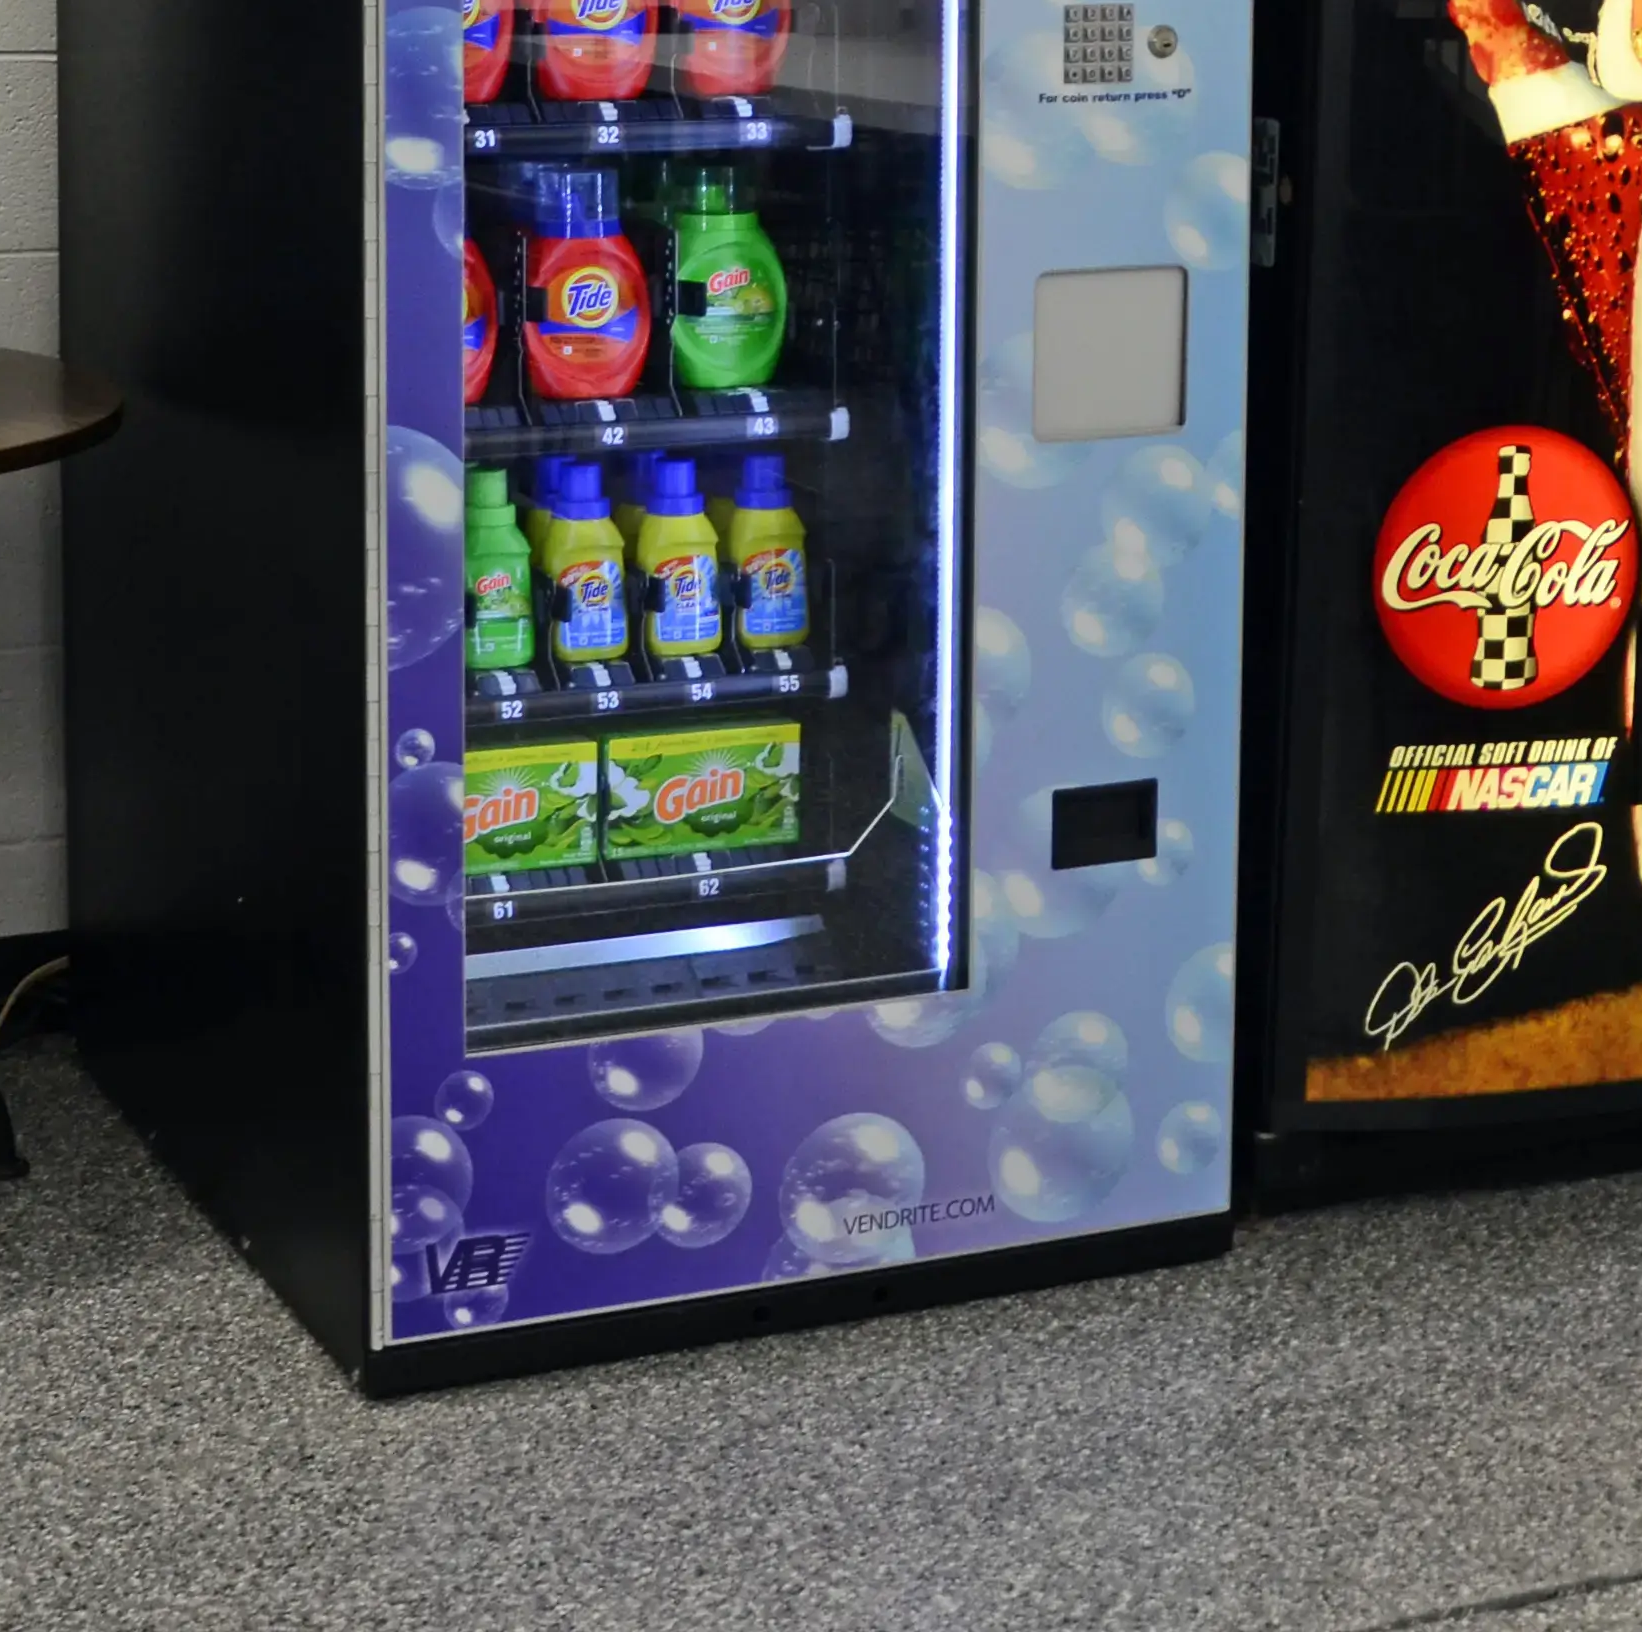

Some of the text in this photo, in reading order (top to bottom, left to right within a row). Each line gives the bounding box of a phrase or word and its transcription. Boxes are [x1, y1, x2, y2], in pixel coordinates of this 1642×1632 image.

[1039, 93, 1058, 103] For
[1062, 92, 1088, 103] coin
[1093, 90, 1131, 102] return
[1134, 90, 1167, 102] press
[474, 129, 496, 148] 31
[597, 126, 619, 144] 32
[746, 122, 768, 140] 33
[708, 268, 750, 296] Gain
[567, 282, 613, 317] Tide
[753, 417, 775, 435] 43
[602, 427, 624, 445] 42
[1382, 518, 1629, 610] Coca-Cola
[475, 573, 511, 595] Gain
[674, 575, 703, 599] Tide
[764, 571, 792, 592] Tide
[580, 581, 609, 603] Tide
[691, 683, 713, 701] 54
[779, 674, 800, 692] 55
[501, 701, 523, 718] 52
[597, 692, 619, 710] 53
[1389, 736, 1619, 768] OFFICIAL SOFT DRINK OF
[655, 767, 746, 824] Gain
[1447, 762, 1598, 811] NASCAR
[700, 810, 737, 824] original
[493, 830, 532, 844] original
[699, 877, 720, 895] 62
[493, 900, 514, 918] 61
[843, 1194, 996, 1235] VENDRITE.COM
